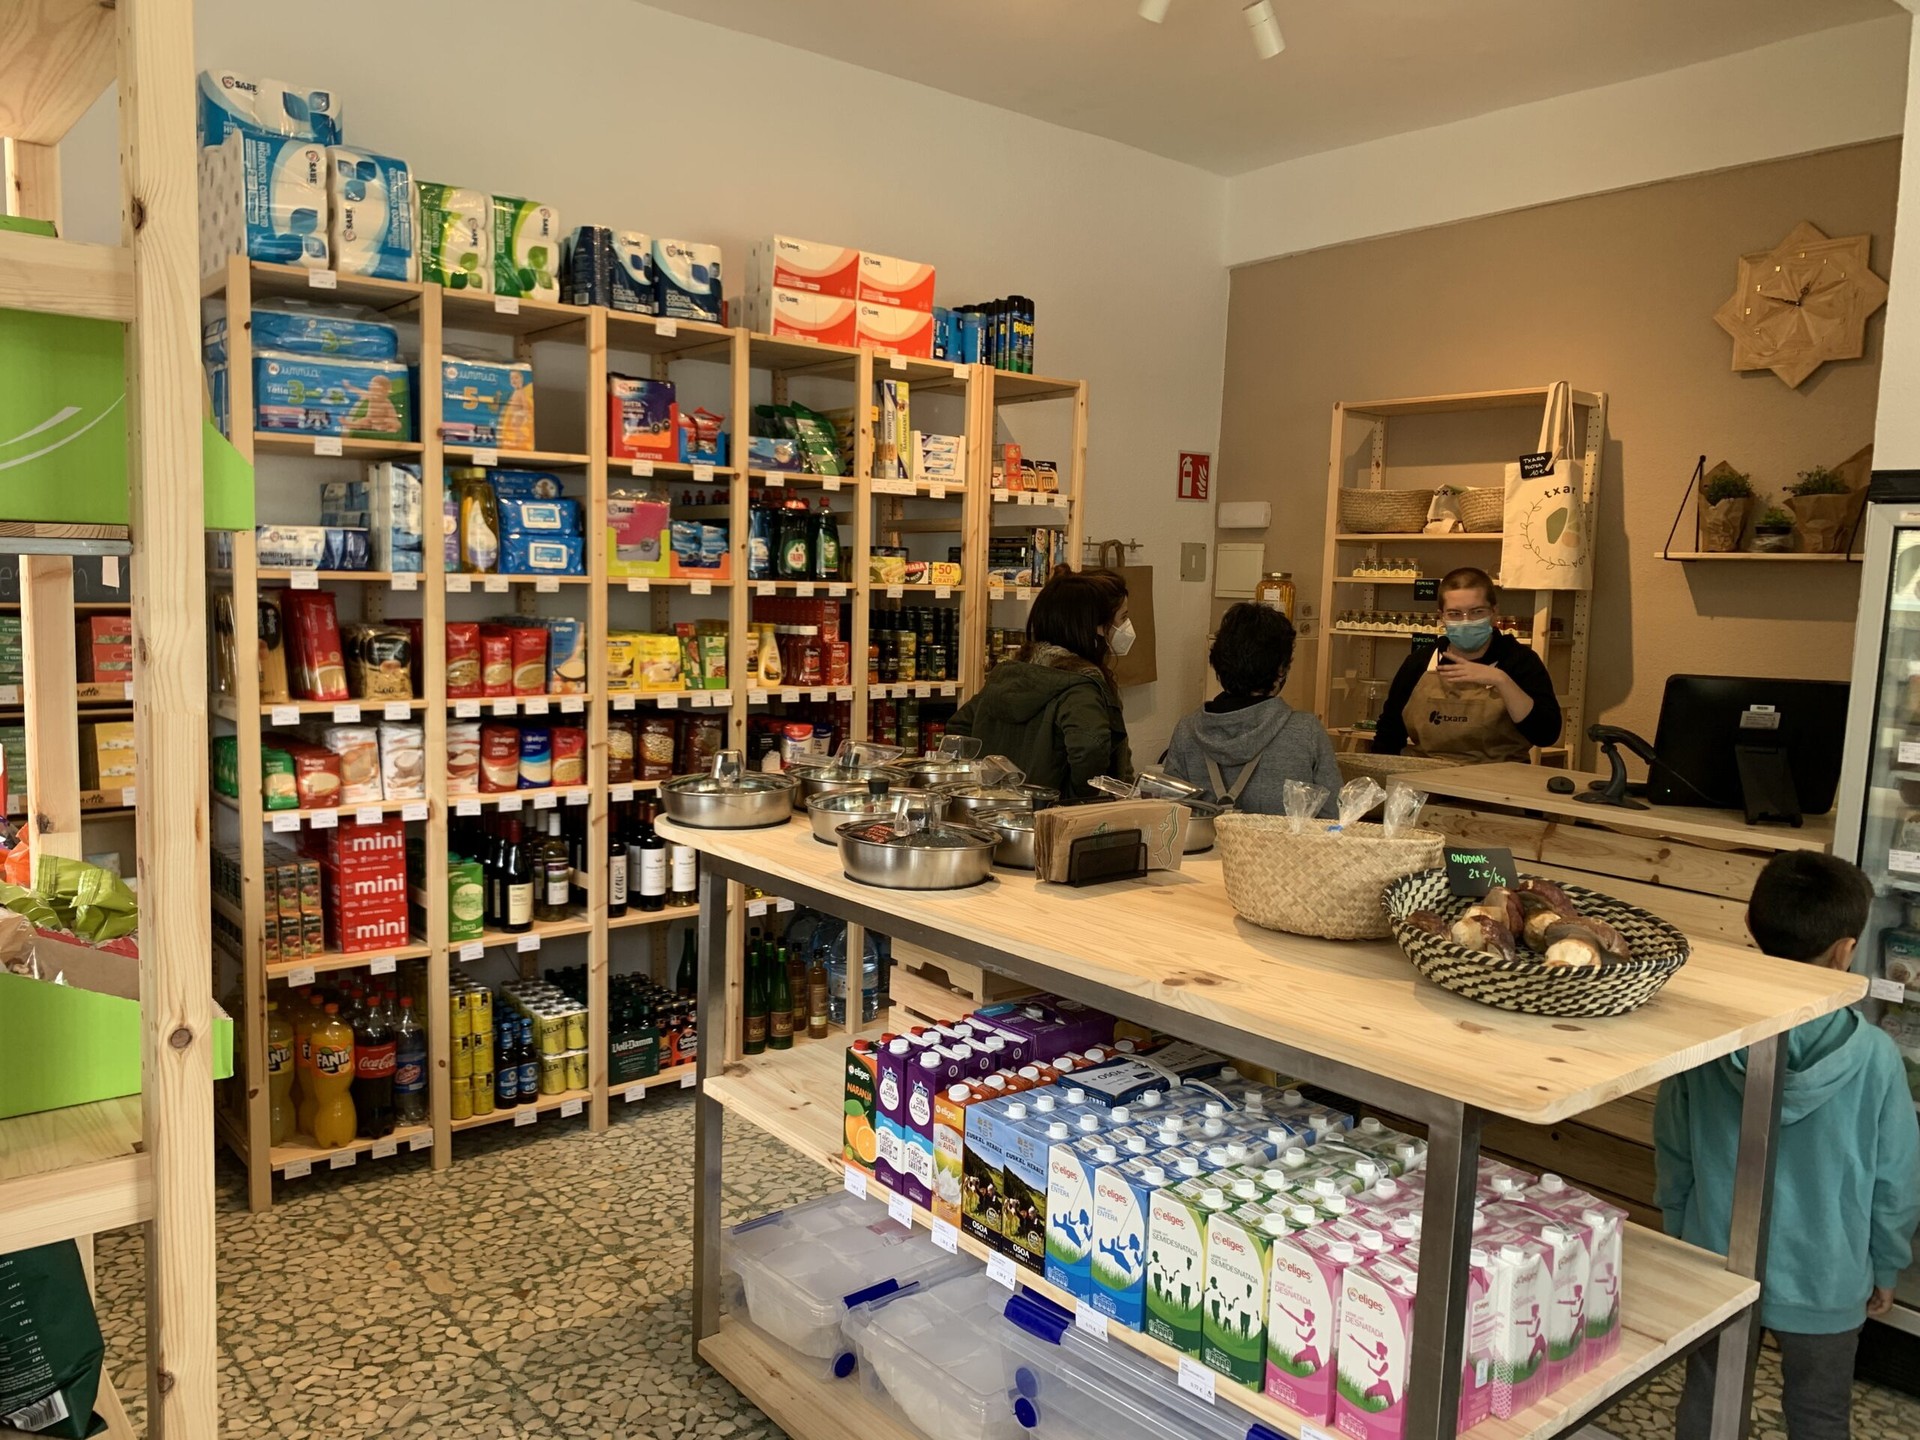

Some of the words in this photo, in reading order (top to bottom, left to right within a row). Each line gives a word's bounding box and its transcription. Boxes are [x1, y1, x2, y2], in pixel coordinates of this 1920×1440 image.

[286, 379, 305, 405] 3
[463, 386, 479, 410] 5
[1444, 713, 1468, 723] txara
[353, 831, 403, 852] mini
[1451, 853, 1490, 864] ONDDOAK
[355, 873, 404, 895] mini
[356, 916, 406, 939] mini
[316, 1050, 350, 1070] FANTA
[854, 1067, 871, 1082] eliges
[1097, 1069, 1125, 1080] OSOA
[847, 1082, 872, 1102] NARANJA
[881, 1088, 898, 1101] LACTOSA
[885, 1083, 895, 1095] SIN
[911, 1102, 929, 1117] LACTOSA
[915, 1098, 925, 1108] SIN
[941, 1107, 956, 1121] eliges
[942, 1143, 958, 1155] AVENA
[966, 1132, 985, 1146] EUSKAL
[986, 1141, 1002, 1154] HERRIA
[1006, 1152, 1025, 1166] EUSKAL
[1026, 1161, 1045, 1176] HERRIA
[1060, 1167, 1078, 1181] eliges
[1051, 1186, 1070, 1199] ENTERA
[1107, 1189, 1127, 1204] eliges
[1097, 1210, 1118, 1223] ENTERA
[1163, 1212, 1185, 1227] eliges
[971, 1220, 988, 1235] OSOA
[1012, 1243, 1030, 1259] OSOA
[1152, 1233, 1198, 1258] SEMIDESNATADA
[1222, 1237, 1245, 1254] eliges
[1210, 1258, 1259, 1286] SEMIDESNATADA
[1287, 1262, 1311, 1281] eliges
[1274, 1285, 1312, 1306] DESNATADA
[1358, 1293, 1383, 1312] eliges
[1345, 1315, 1384, 1339] DESNATADA
